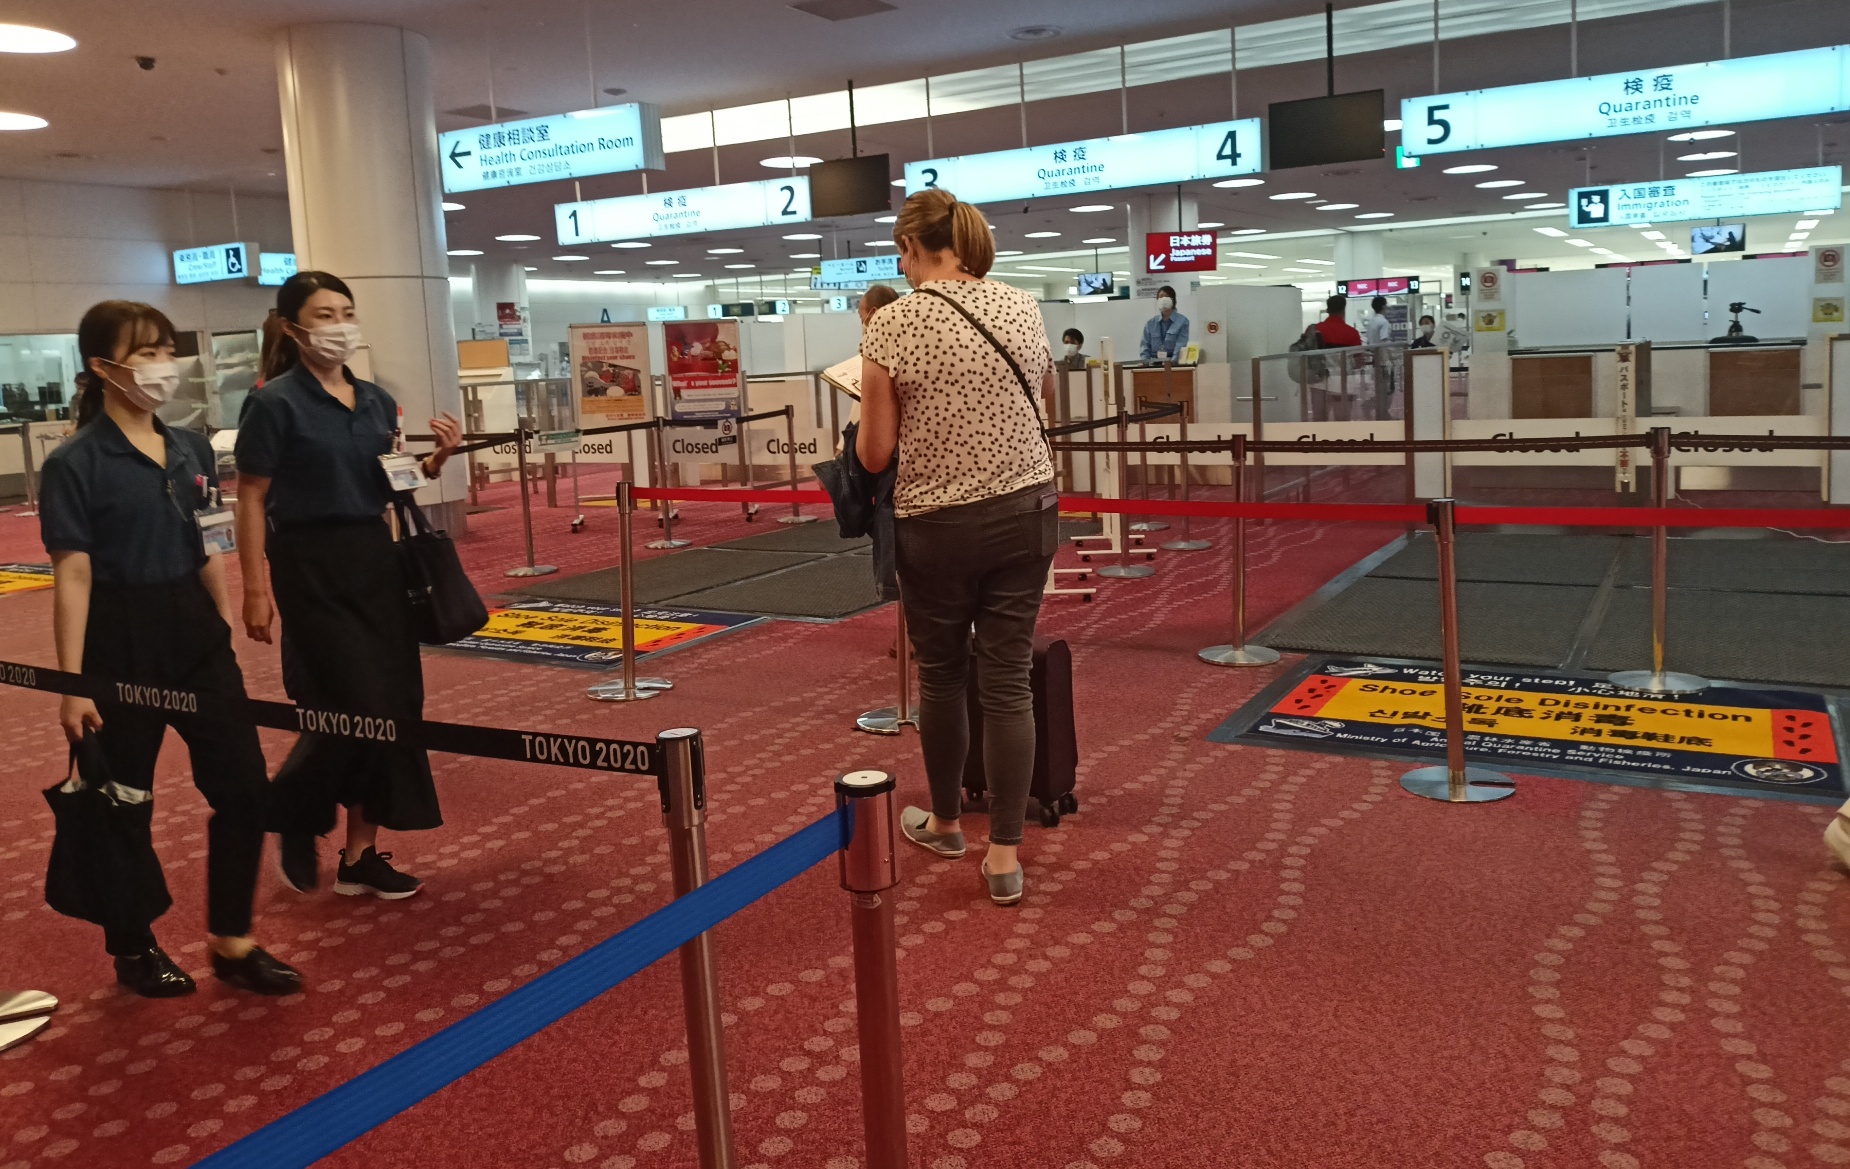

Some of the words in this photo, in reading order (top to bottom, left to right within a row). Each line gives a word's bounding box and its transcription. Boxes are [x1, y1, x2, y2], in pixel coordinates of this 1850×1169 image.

[1624, 74, 1673, 95] 検疫
[1598, 94, 1699, 116] Quarantine
[1427, 103, 1451, 145] 5
[478, 125, 551, 150] 健康相談室
[1216, 129, 1242, 167] 4
[479, 152, 516, 167] Health
[519, 141, 594, 162] Consultation
[597, 136, 634, 150] Room
[1053, 147, 1086, 163] 検疫
[1037, 163, 1104, 180] Quarantine
[780, 185, 797, 216] 2
[1618, 185, 1676, 200] 入国審査
[652, 210, 701, 222] Quarantine
[1617, 199, 1690, 211] Immigration
[568, 209, 579, 236] 1
[1170, 248, 1212, 256] Japanese
[493, 440, 531, 454] Closd
[672, 438, 719, 454] Closed
[8, 665, 36, 687] 2020
[1403, 668, 1445, 676] Watc
[1469, 673, 1514, 681] your
[1521, 678, 1576, 687] step!
[116, 682, 160, 708] TOKYO
[162, 689, 197, 713] 2020
[1359, 684, 1437, 697] Shoe
[1461, 692, 1524, 704] Sole
[1538, 698, 1753, 722] Disinfection
[296, 708, 351, 736] TOKYO
[353, 715, 396, 742] 2020
[521, 734, 591, 765] TOKYO
[595, 742, 649, 771] 2020
[1336, 733, 1388, 742] Ministry
[1498, 748, 1550, 760] Forestry
[1681, 766, 1732, 776] Japan
[1481, 741, 1561, 754] Quarantine
[1566, 749, 1625, 760] Service
